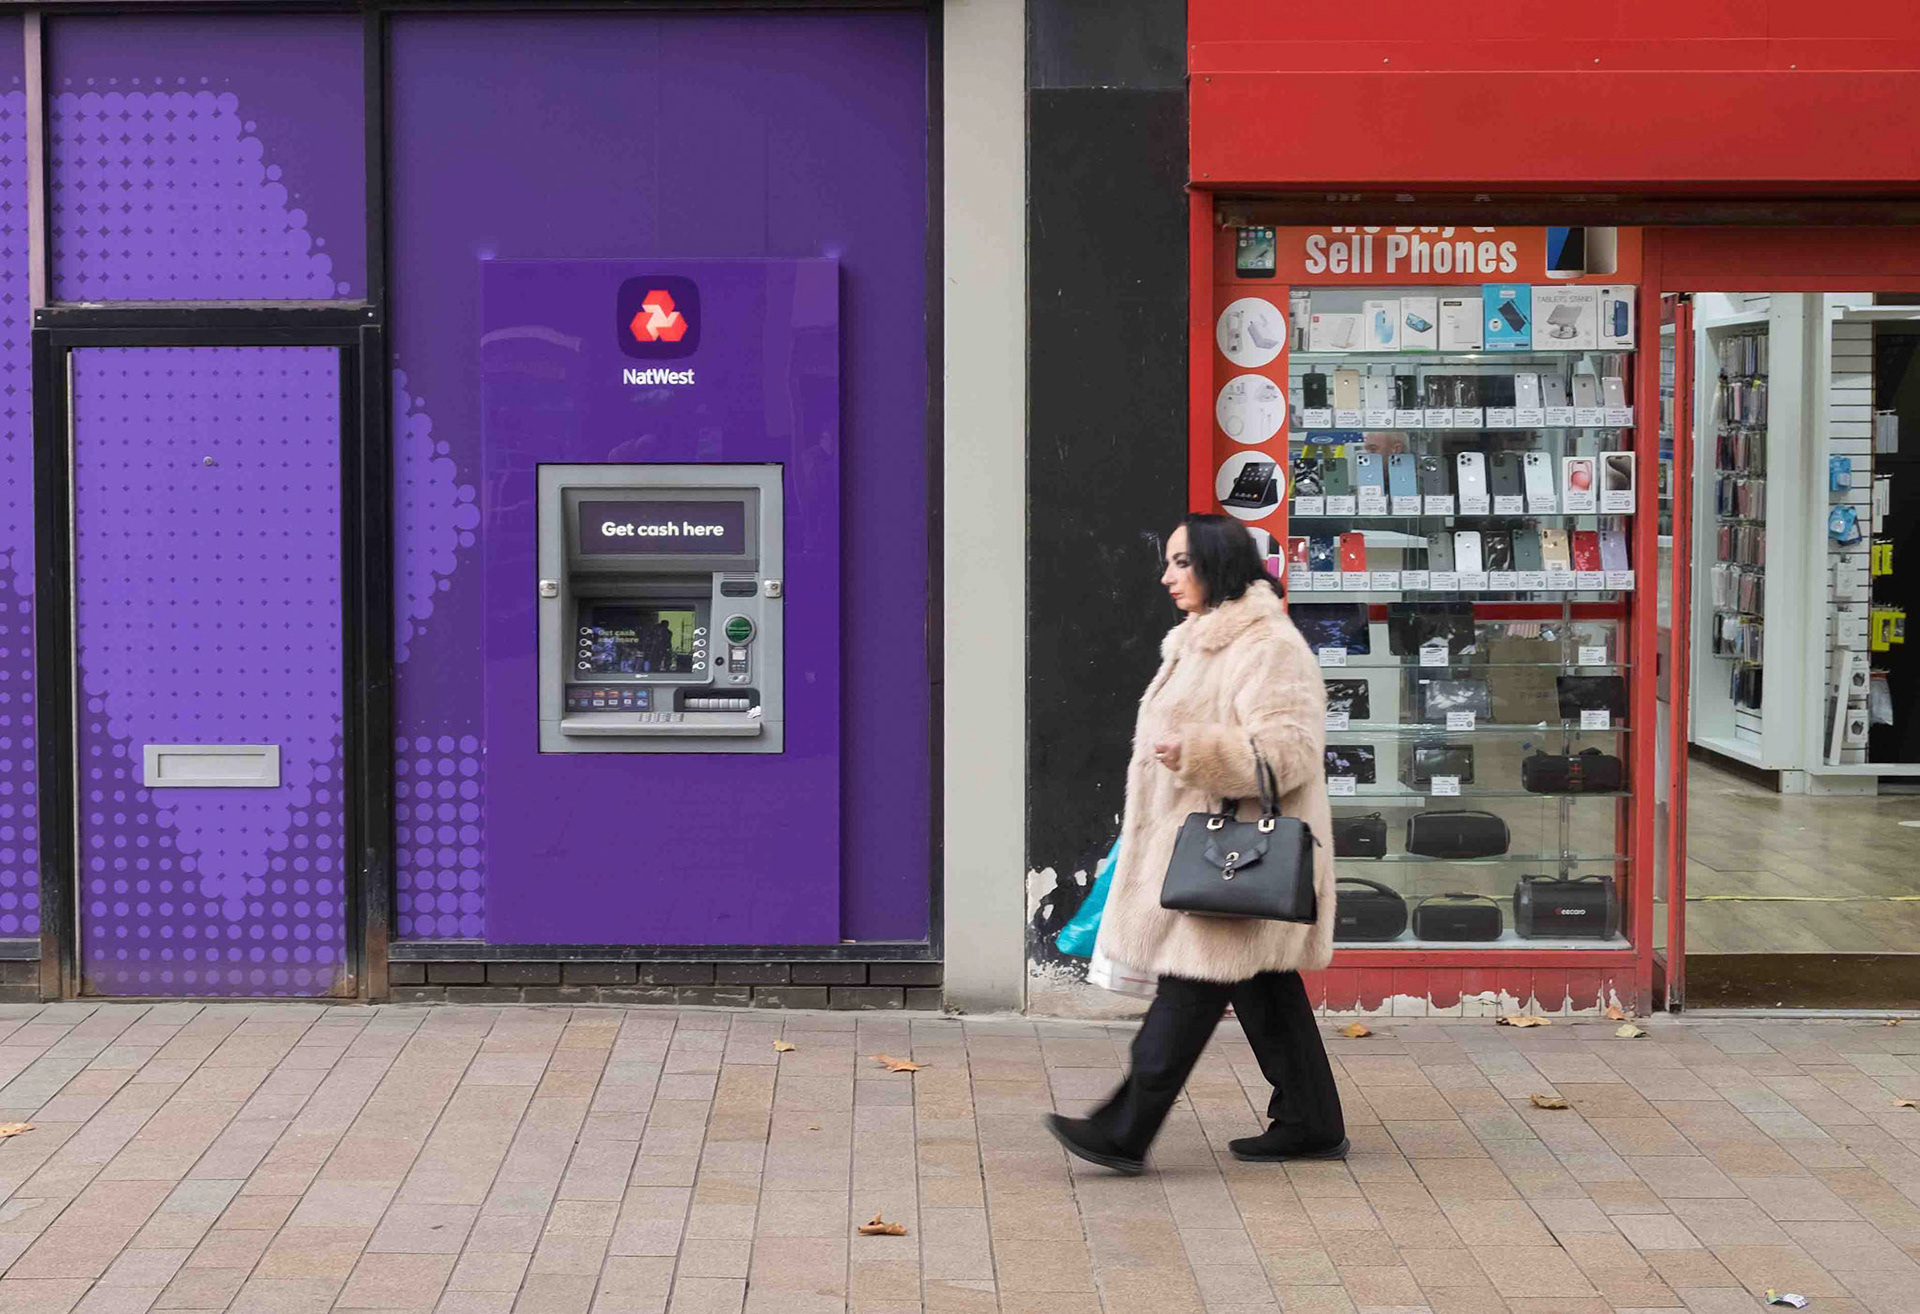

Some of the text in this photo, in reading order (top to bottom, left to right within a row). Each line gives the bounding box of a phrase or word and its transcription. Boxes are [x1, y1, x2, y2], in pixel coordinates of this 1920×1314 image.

[1305, 234, 1518, 274] Sell Phones
[623, 368, 695, 385] NatWest
[602, 521, 725, 537] Get cash here
